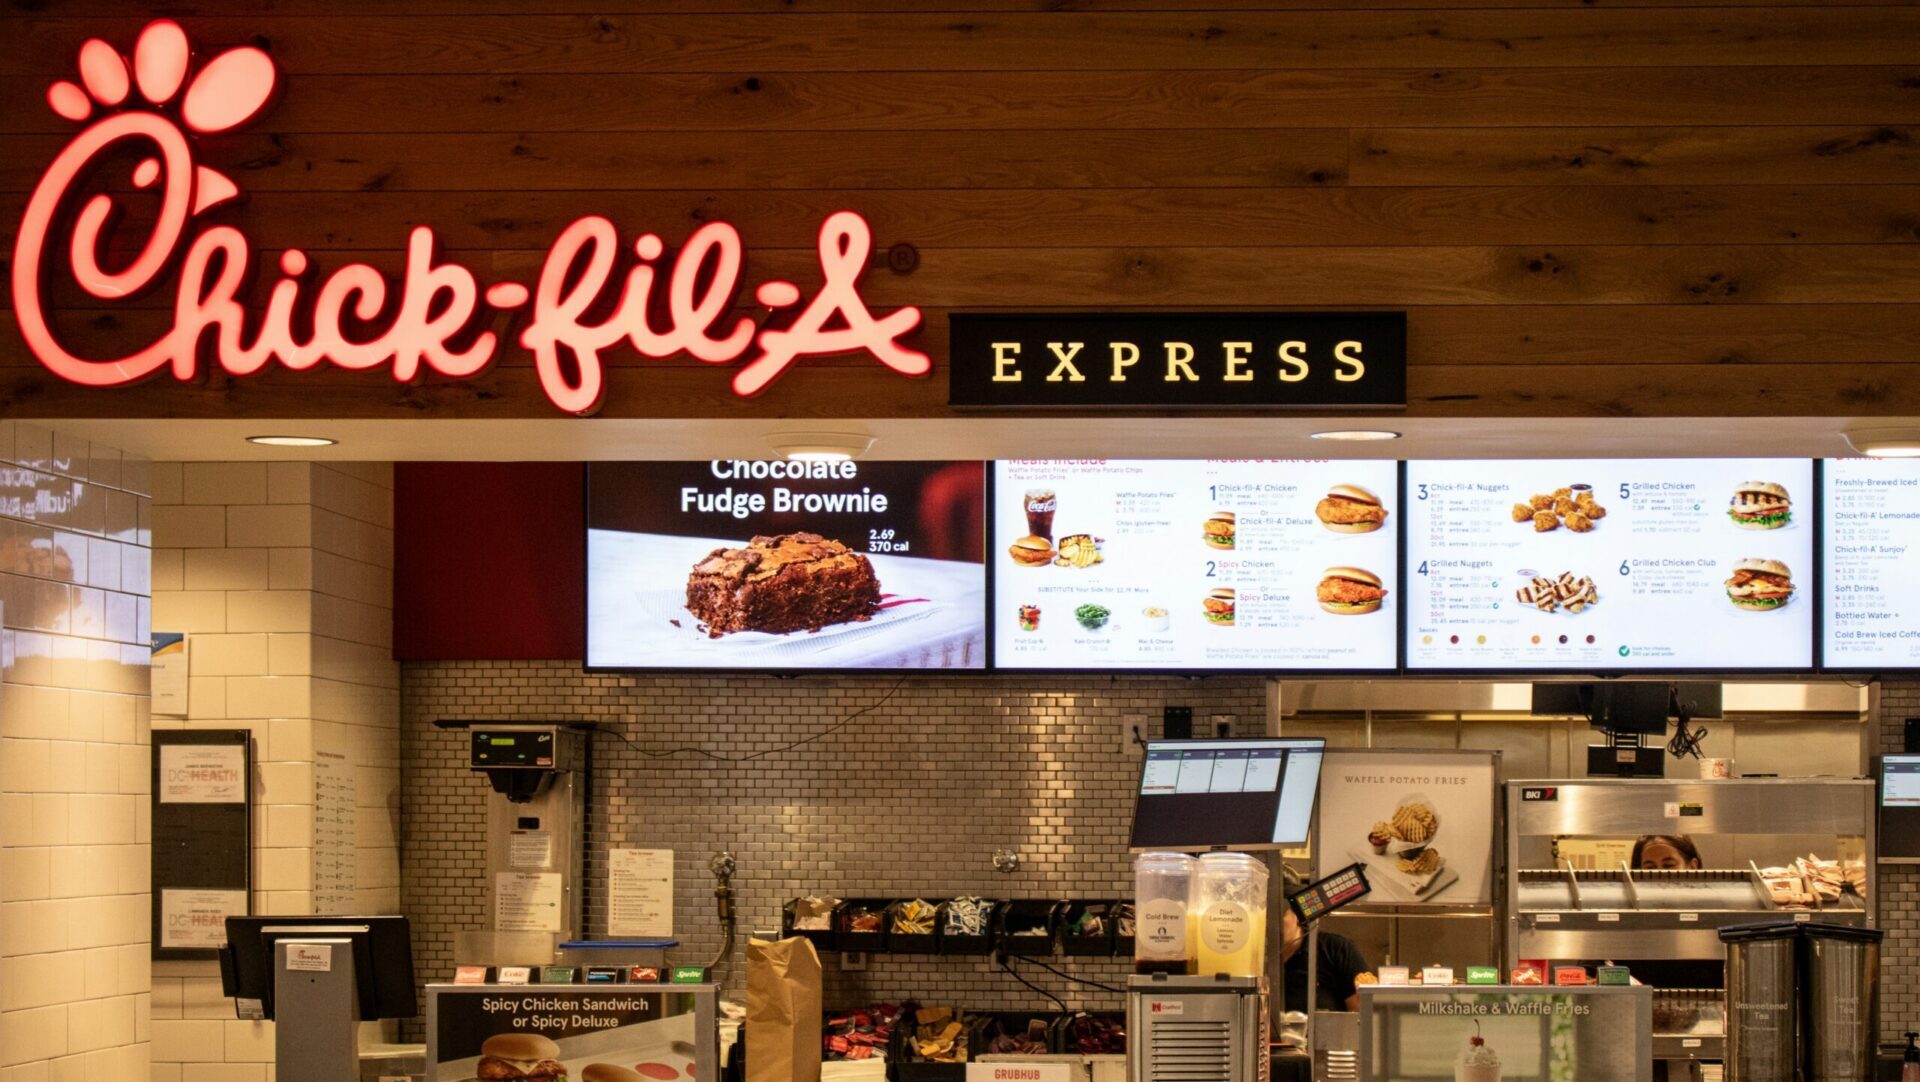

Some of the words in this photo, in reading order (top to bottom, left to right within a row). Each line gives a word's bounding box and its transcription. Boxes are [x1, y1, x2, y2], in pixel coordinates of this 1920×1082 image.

[12, 112, 932, 413] Chick-fil-A
[991, 341, 1366, 382] EXPRESS
[711, 460, 857, 479] Chocolate
[1835, 479, 1898, 488] Freshly-Brewed
[1209, 485, 1216, 501] 1
[1417, 484, 1428, 500] 3
[1477, 483, 1509, 492] Nuggets
[1620, 483, 1630, 500] 5
[1632, 482, 1660, 490] Grilled
[1662, 482, 1696, 490] Chicken
[681, 487, 765, 518] Fudge
[773, 487, 888, 512] Brownie
[869, 529, 894, 540] 2.69
[869, 541, 891, 552] 370
[893, 541, 909, 552] cal
[1206, 561, 1216, 577] 2
[1218, 561, 1239, 569] Spicy
[1241, 560, 1275, 568] Chicken
[1417, 560, 1429, 576] 4
[1460, 560, 1493, 569] Nuggets
[1619, 560, 1630, 576] 6
[1632, 559, 1660, 567] Grilled
[1662, 559, 1696, 567] Chicken
[1697, 559, 1716, 567] Club
[1239, 594, 1260, 602] Spicy
[1835, 611, 1866, 619] Bottled
[1867, 611, 1892, 619] Water
[1835, 630, 1854, 638] Cold
[1856, 630, 1876, 638] Brew
[1879, 630, 1897, 638] Iced
[191, 769, 238, 782] HEALTH
[1345, 776, 1385, 784] WAFFLE
[1390, 776, 1430, 784] POTATO
[1435, 777, 1466, 785] FRIES
[191, 914, 225, 927] HEAL
[1163, 913, 1179, 921] Brew
[677, 969, 701, 978] Sprite
[1471, 971, 1495, 979] Sprite
[482, 998, 518, 1014] Spicy
[522, 998, 579, 1011] Chicken
[582, 998, 648, 1011] Sandwich
[1419, 1002, 1487, 1015] Milkshake
[1492, 1003, 1500, 1015] &
[1505, 1002, 1551, 1015] Waffle
[1555, 1002, 1590, 1015] Fries
[1736, 1002, 1788, 1010] Unsweetened
[513, 1019, 528, 1028] or
[531, 1015, 567, 1030] Spicy
[572, 1015, 618, 1028] Deluxe
[1755, 1012, 1769, 1020] Tea
[995, 1069, 1040, 1079] GRUBHUB
